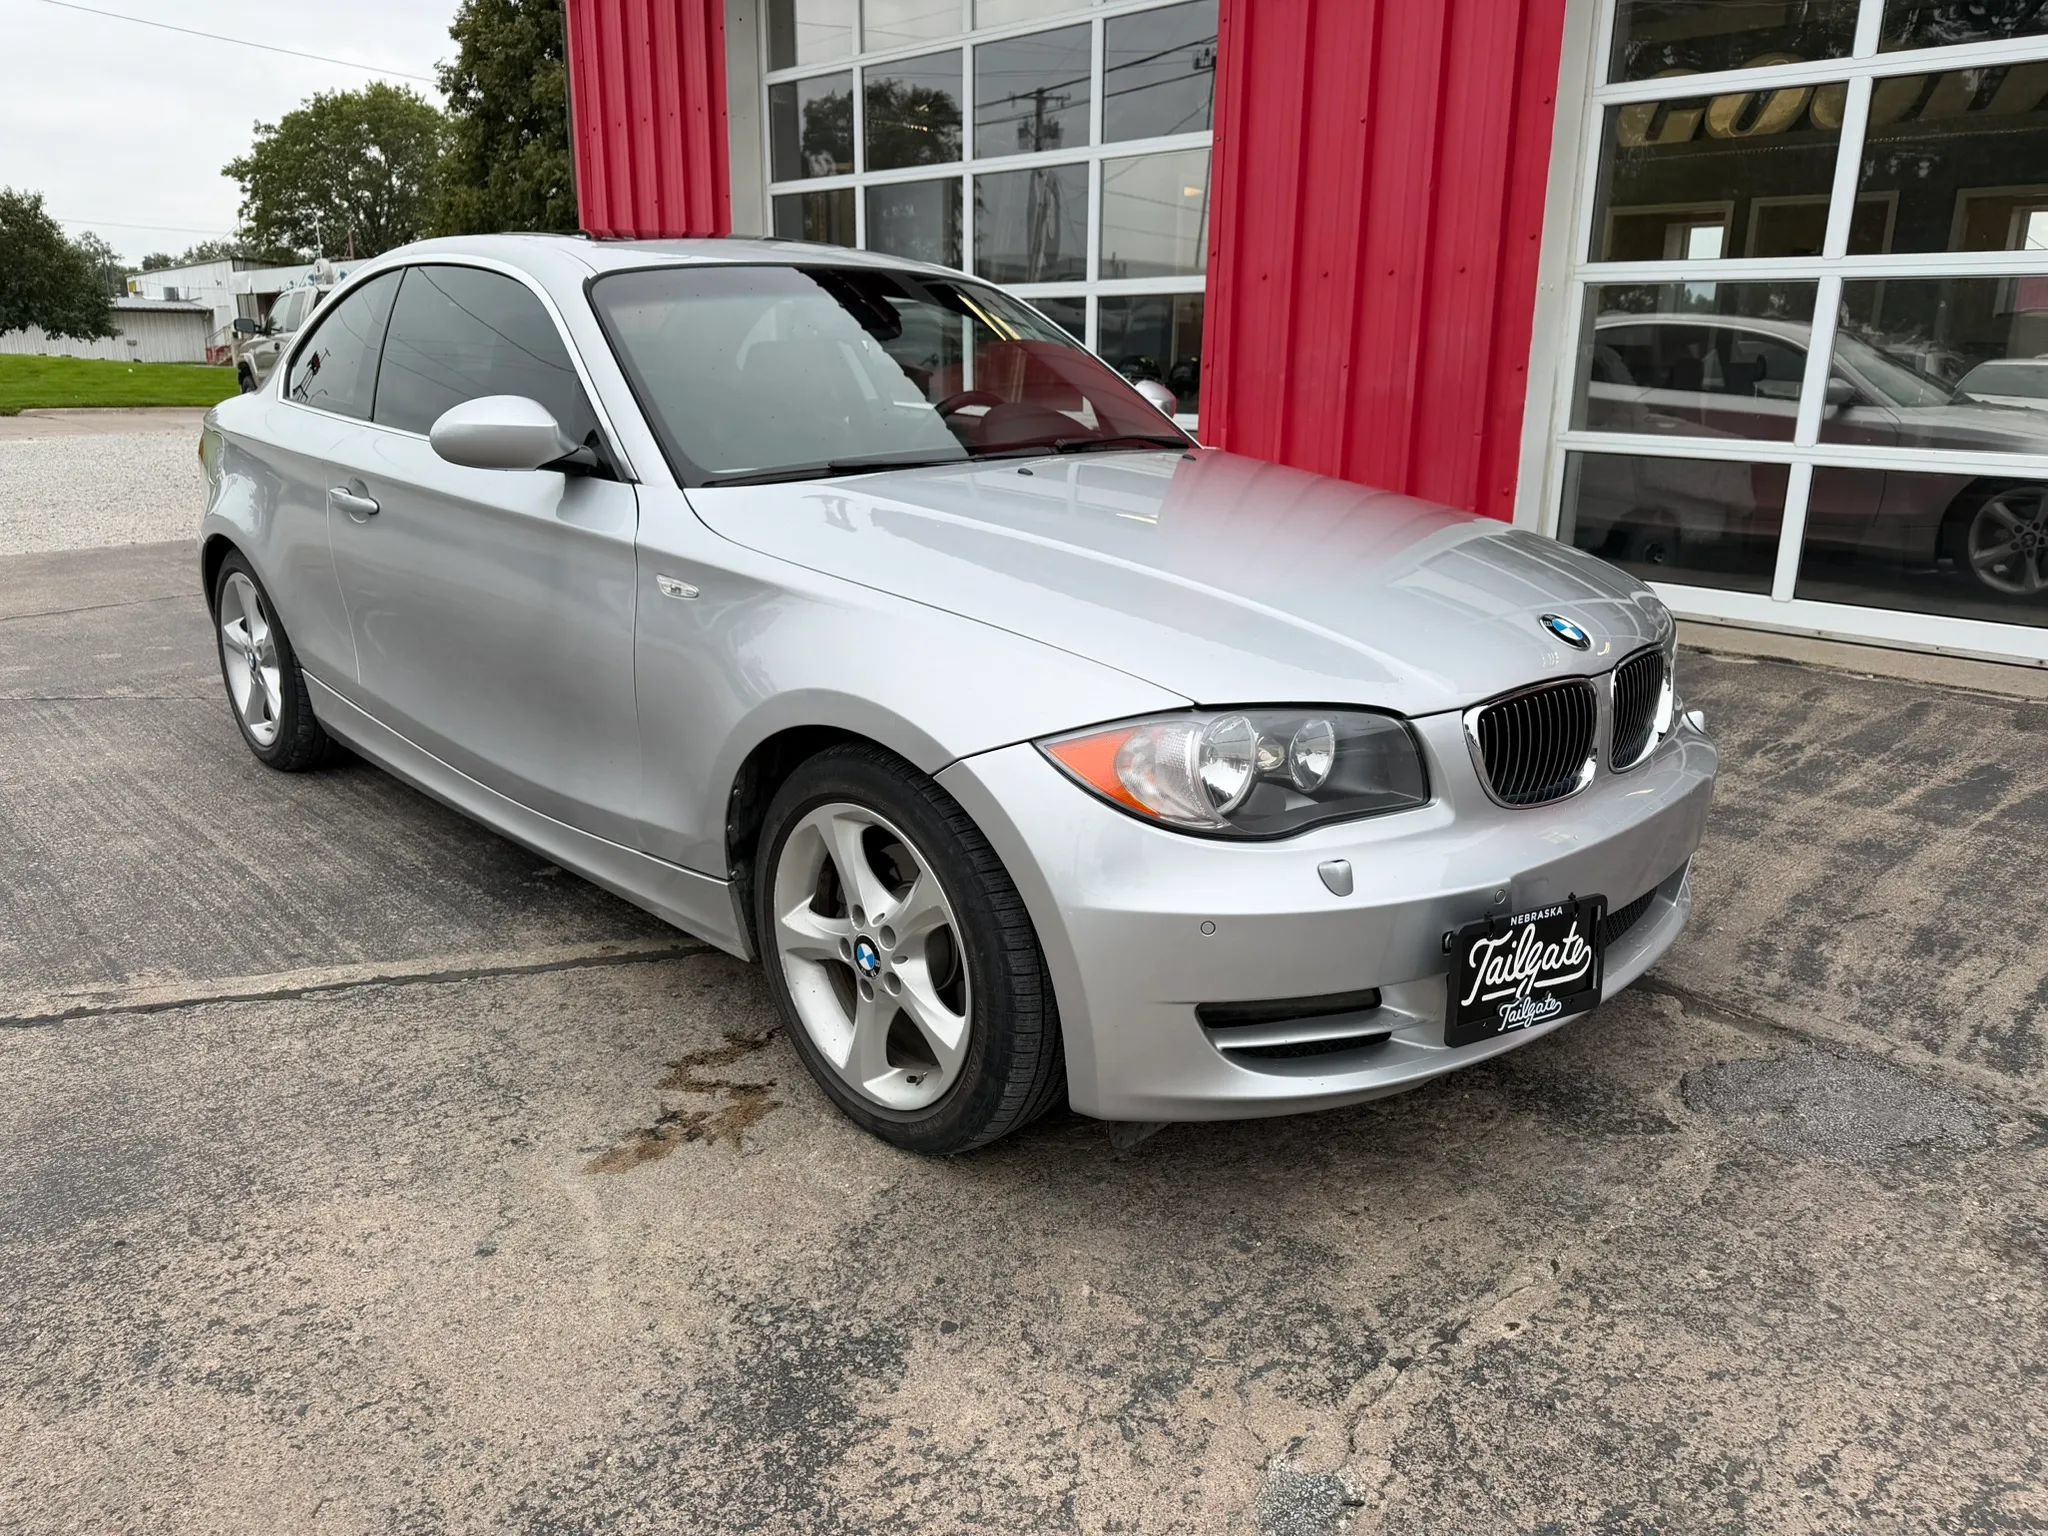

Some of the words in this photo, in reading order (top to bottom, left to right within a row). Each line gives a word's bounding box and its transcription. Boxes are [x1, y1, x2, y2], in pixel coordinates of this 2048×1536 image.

[1510, 906, 1563, 926] NEBRASKA
[1461, 921, 1592, 1006] Tailgate
[1498, 993, 1562, 1032] Tailgate
